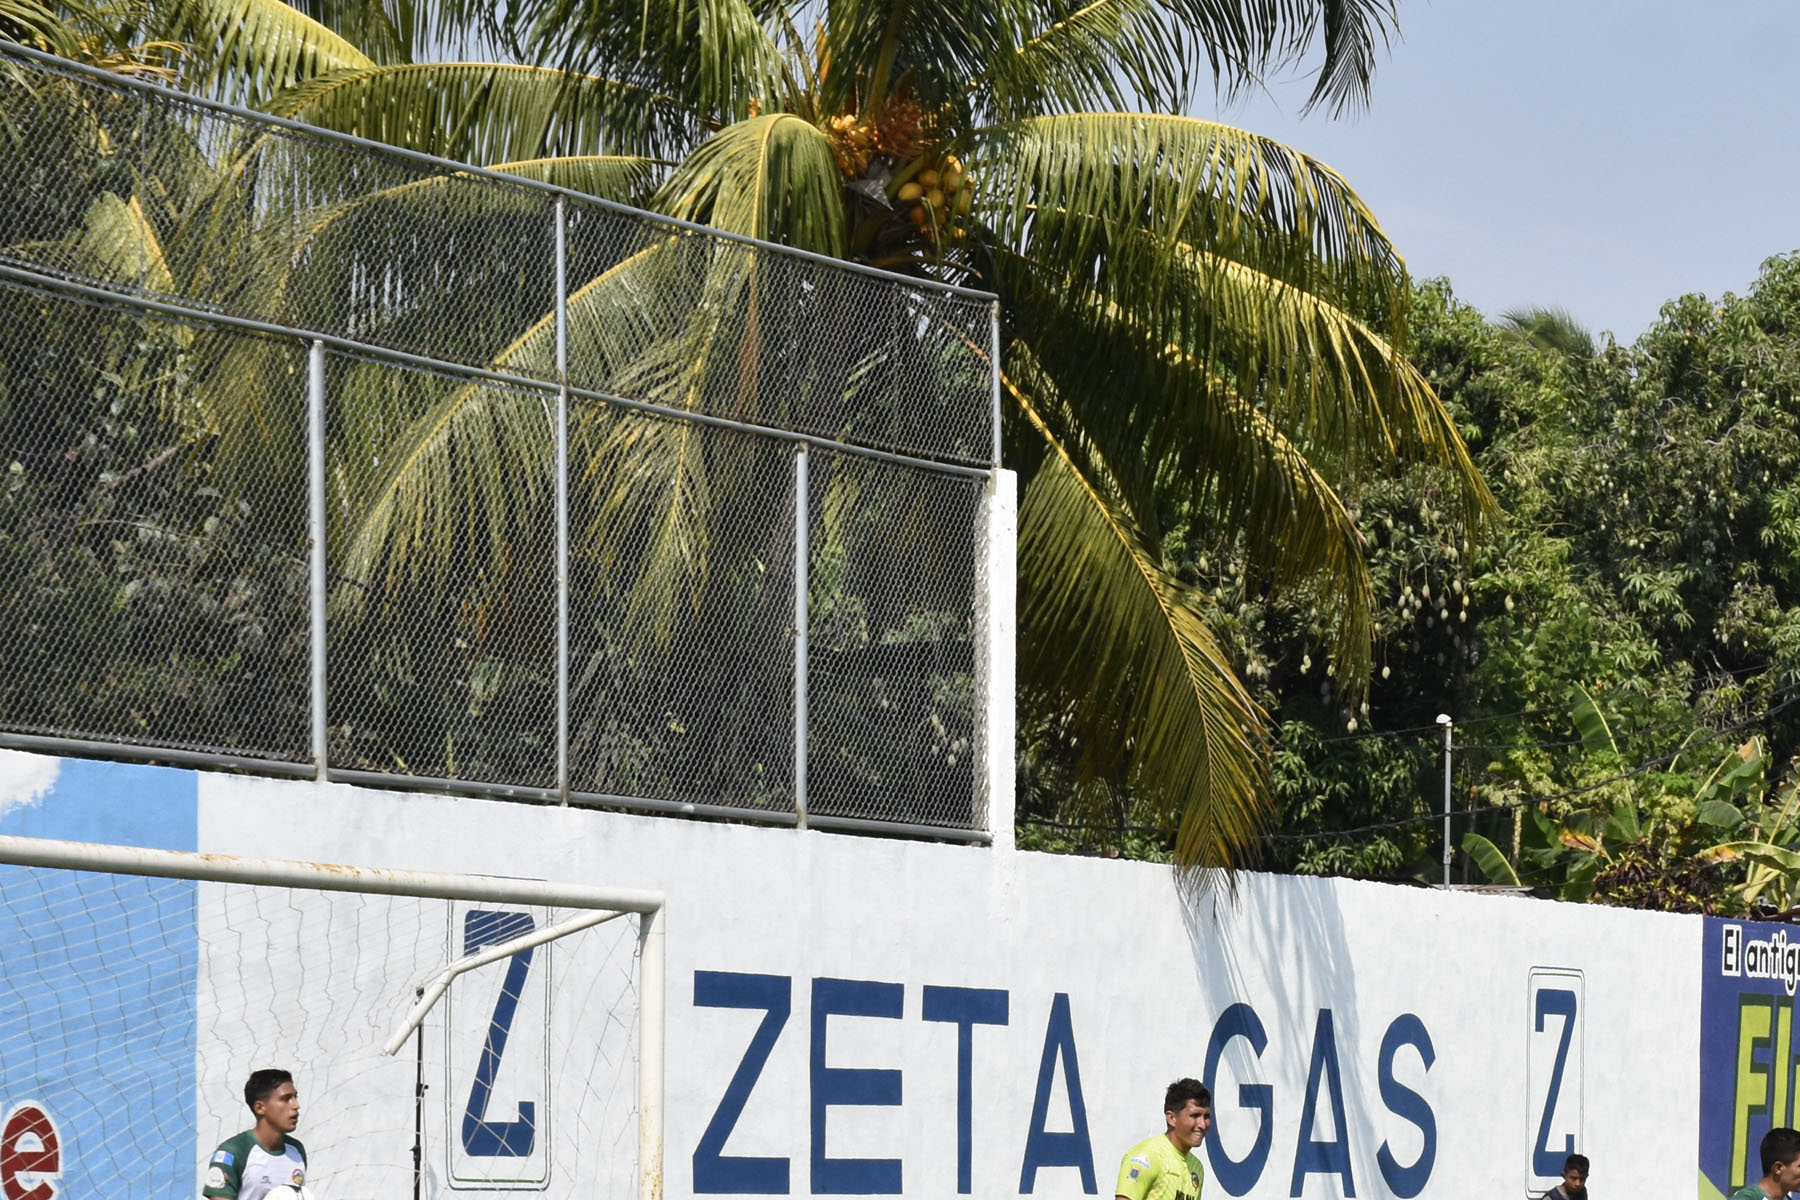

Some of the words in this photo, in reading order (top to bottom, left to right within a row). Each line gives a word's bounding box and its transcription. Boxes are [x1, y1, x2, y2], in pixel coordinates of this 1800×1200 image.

[1723, 926, 1741, 974] El
[693, 970, 1098, 1195] ZETA
[1203, 1003, 1437, 1199] GAS
